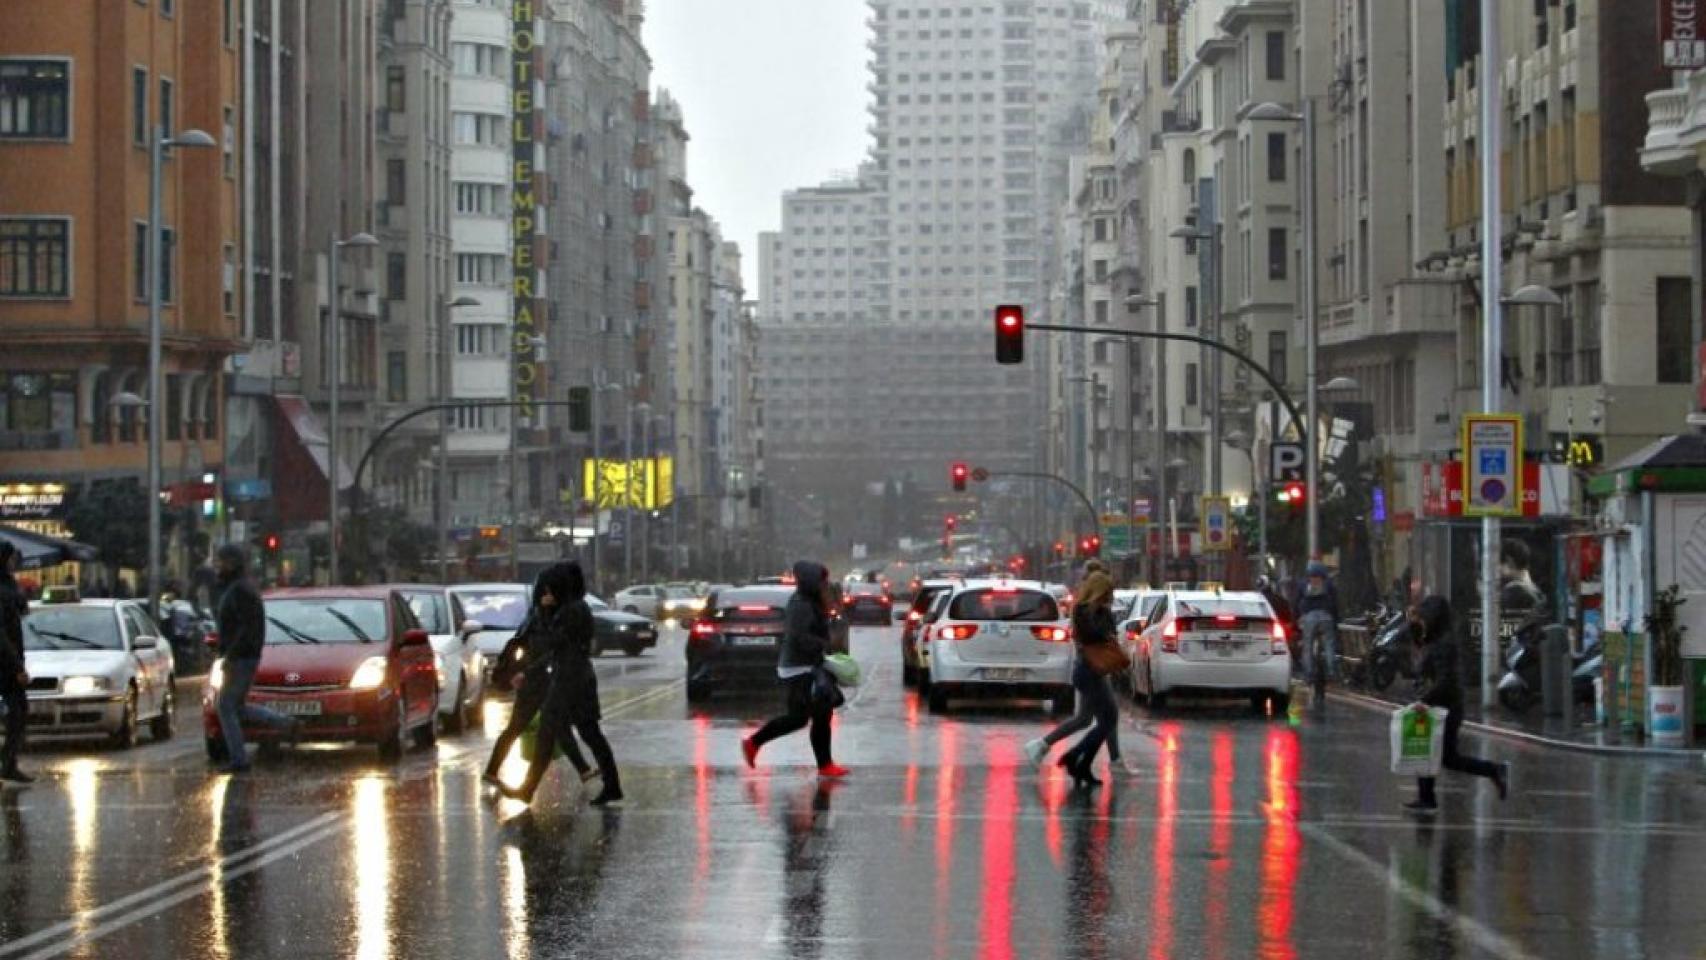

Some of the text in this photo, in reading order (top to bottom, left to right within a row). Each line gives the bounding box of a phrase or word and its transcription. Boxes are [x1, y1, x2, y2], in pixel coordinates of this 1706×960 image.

[514, 1, 535, 417] HOTEL EMPERADOR
[1273, 444, 1303, 481] P
